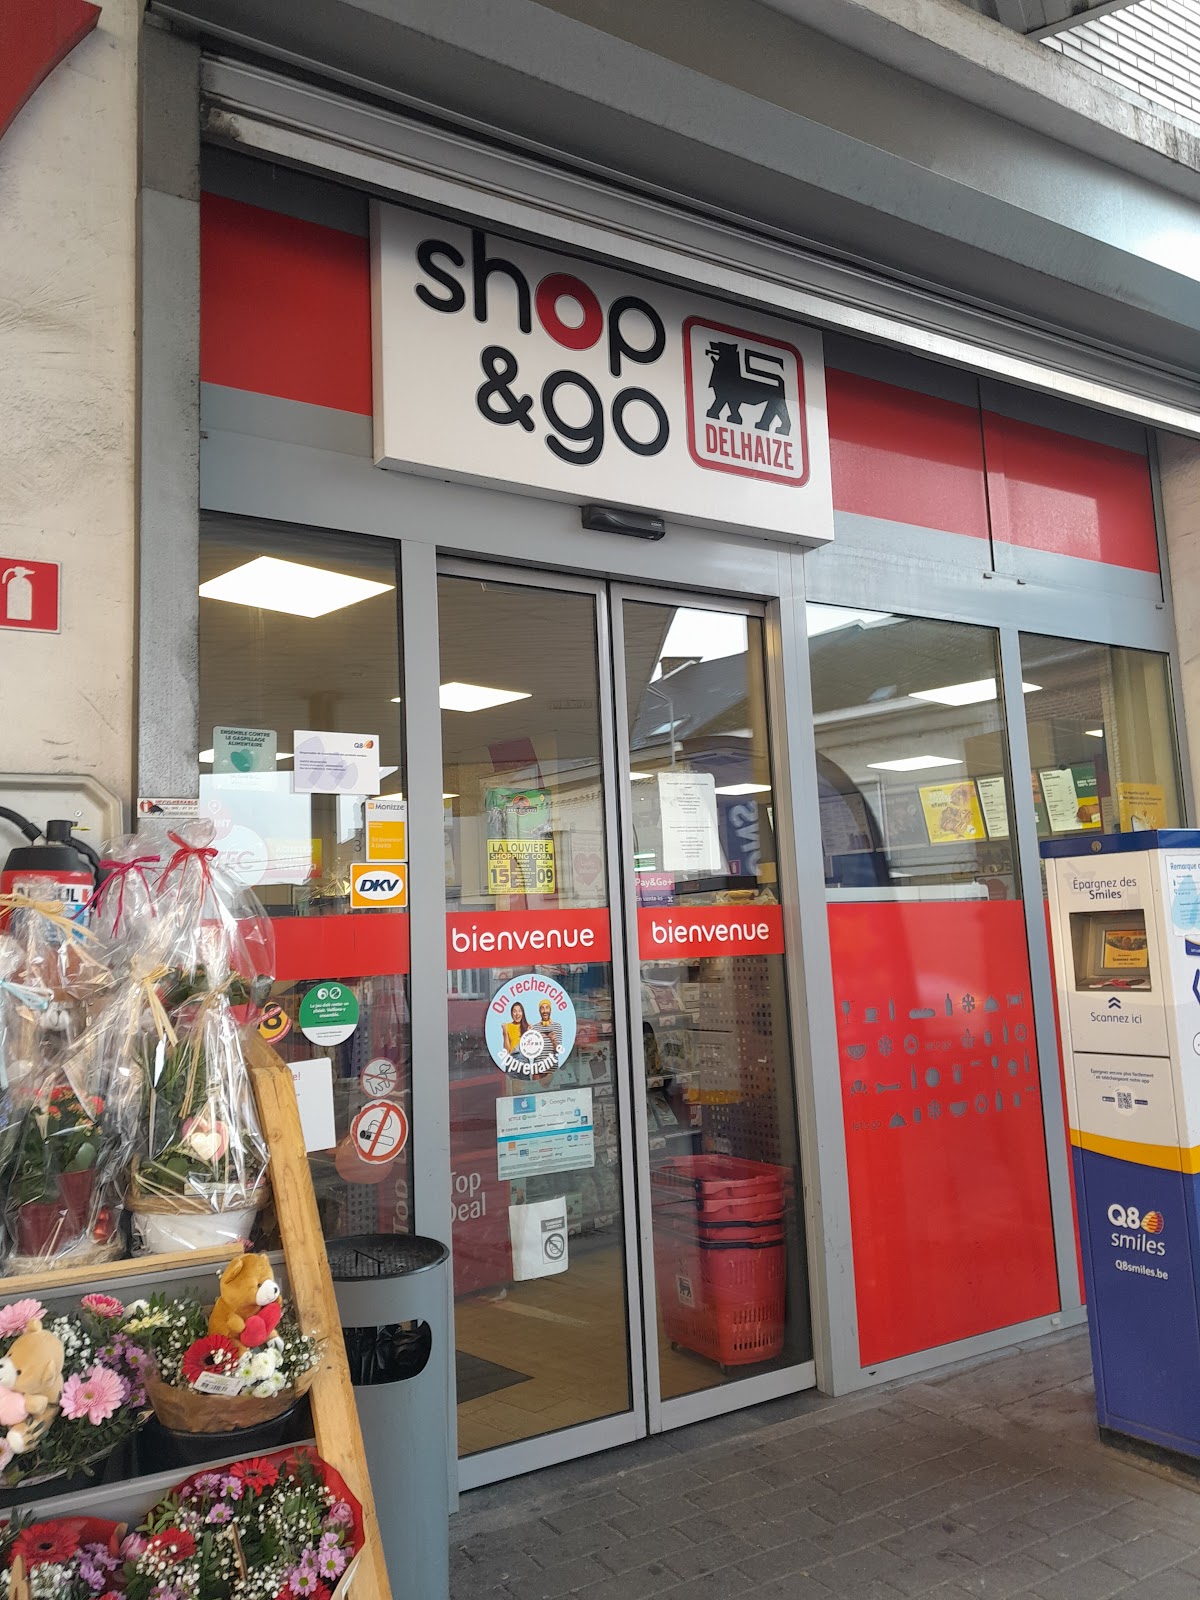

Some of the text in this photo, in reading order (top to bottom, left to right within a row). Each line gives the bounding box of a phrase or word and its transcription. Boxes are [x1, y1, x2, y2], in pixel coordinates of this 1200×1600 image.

[415, 229, 666, 378] shop
[476, 344, 670, 465] &go
[705, 423, 794, 471] DELHAIZE
[375, 803, 405, 811] Monizze
[492, 843, 505, 853] LA
[1170, 862, 1197, 871] Remarque
[359, 879, 400, 892] DKV
[490, 869, 510, 884] 15
[537, 869, 554, 884] 09
[1073, 876, 1137, 891] Épargnez des
[1089, 888, 1122, 900] Smiles
[452, 925, 594, 953] bienvenue
[651, 919, 769, 944] bienvenue
[492, 976, 568, 1014] On recherche
[1090, 1012, 1142, 1024] Scannez ici
[549, 1097, 566, 1105] Google
[1107, 1203, 1141, 1230] Q8
[1111, 1232, 1166, 1256] smiles
[1115, 1259, 1169, 1280] Q8smiles.be
